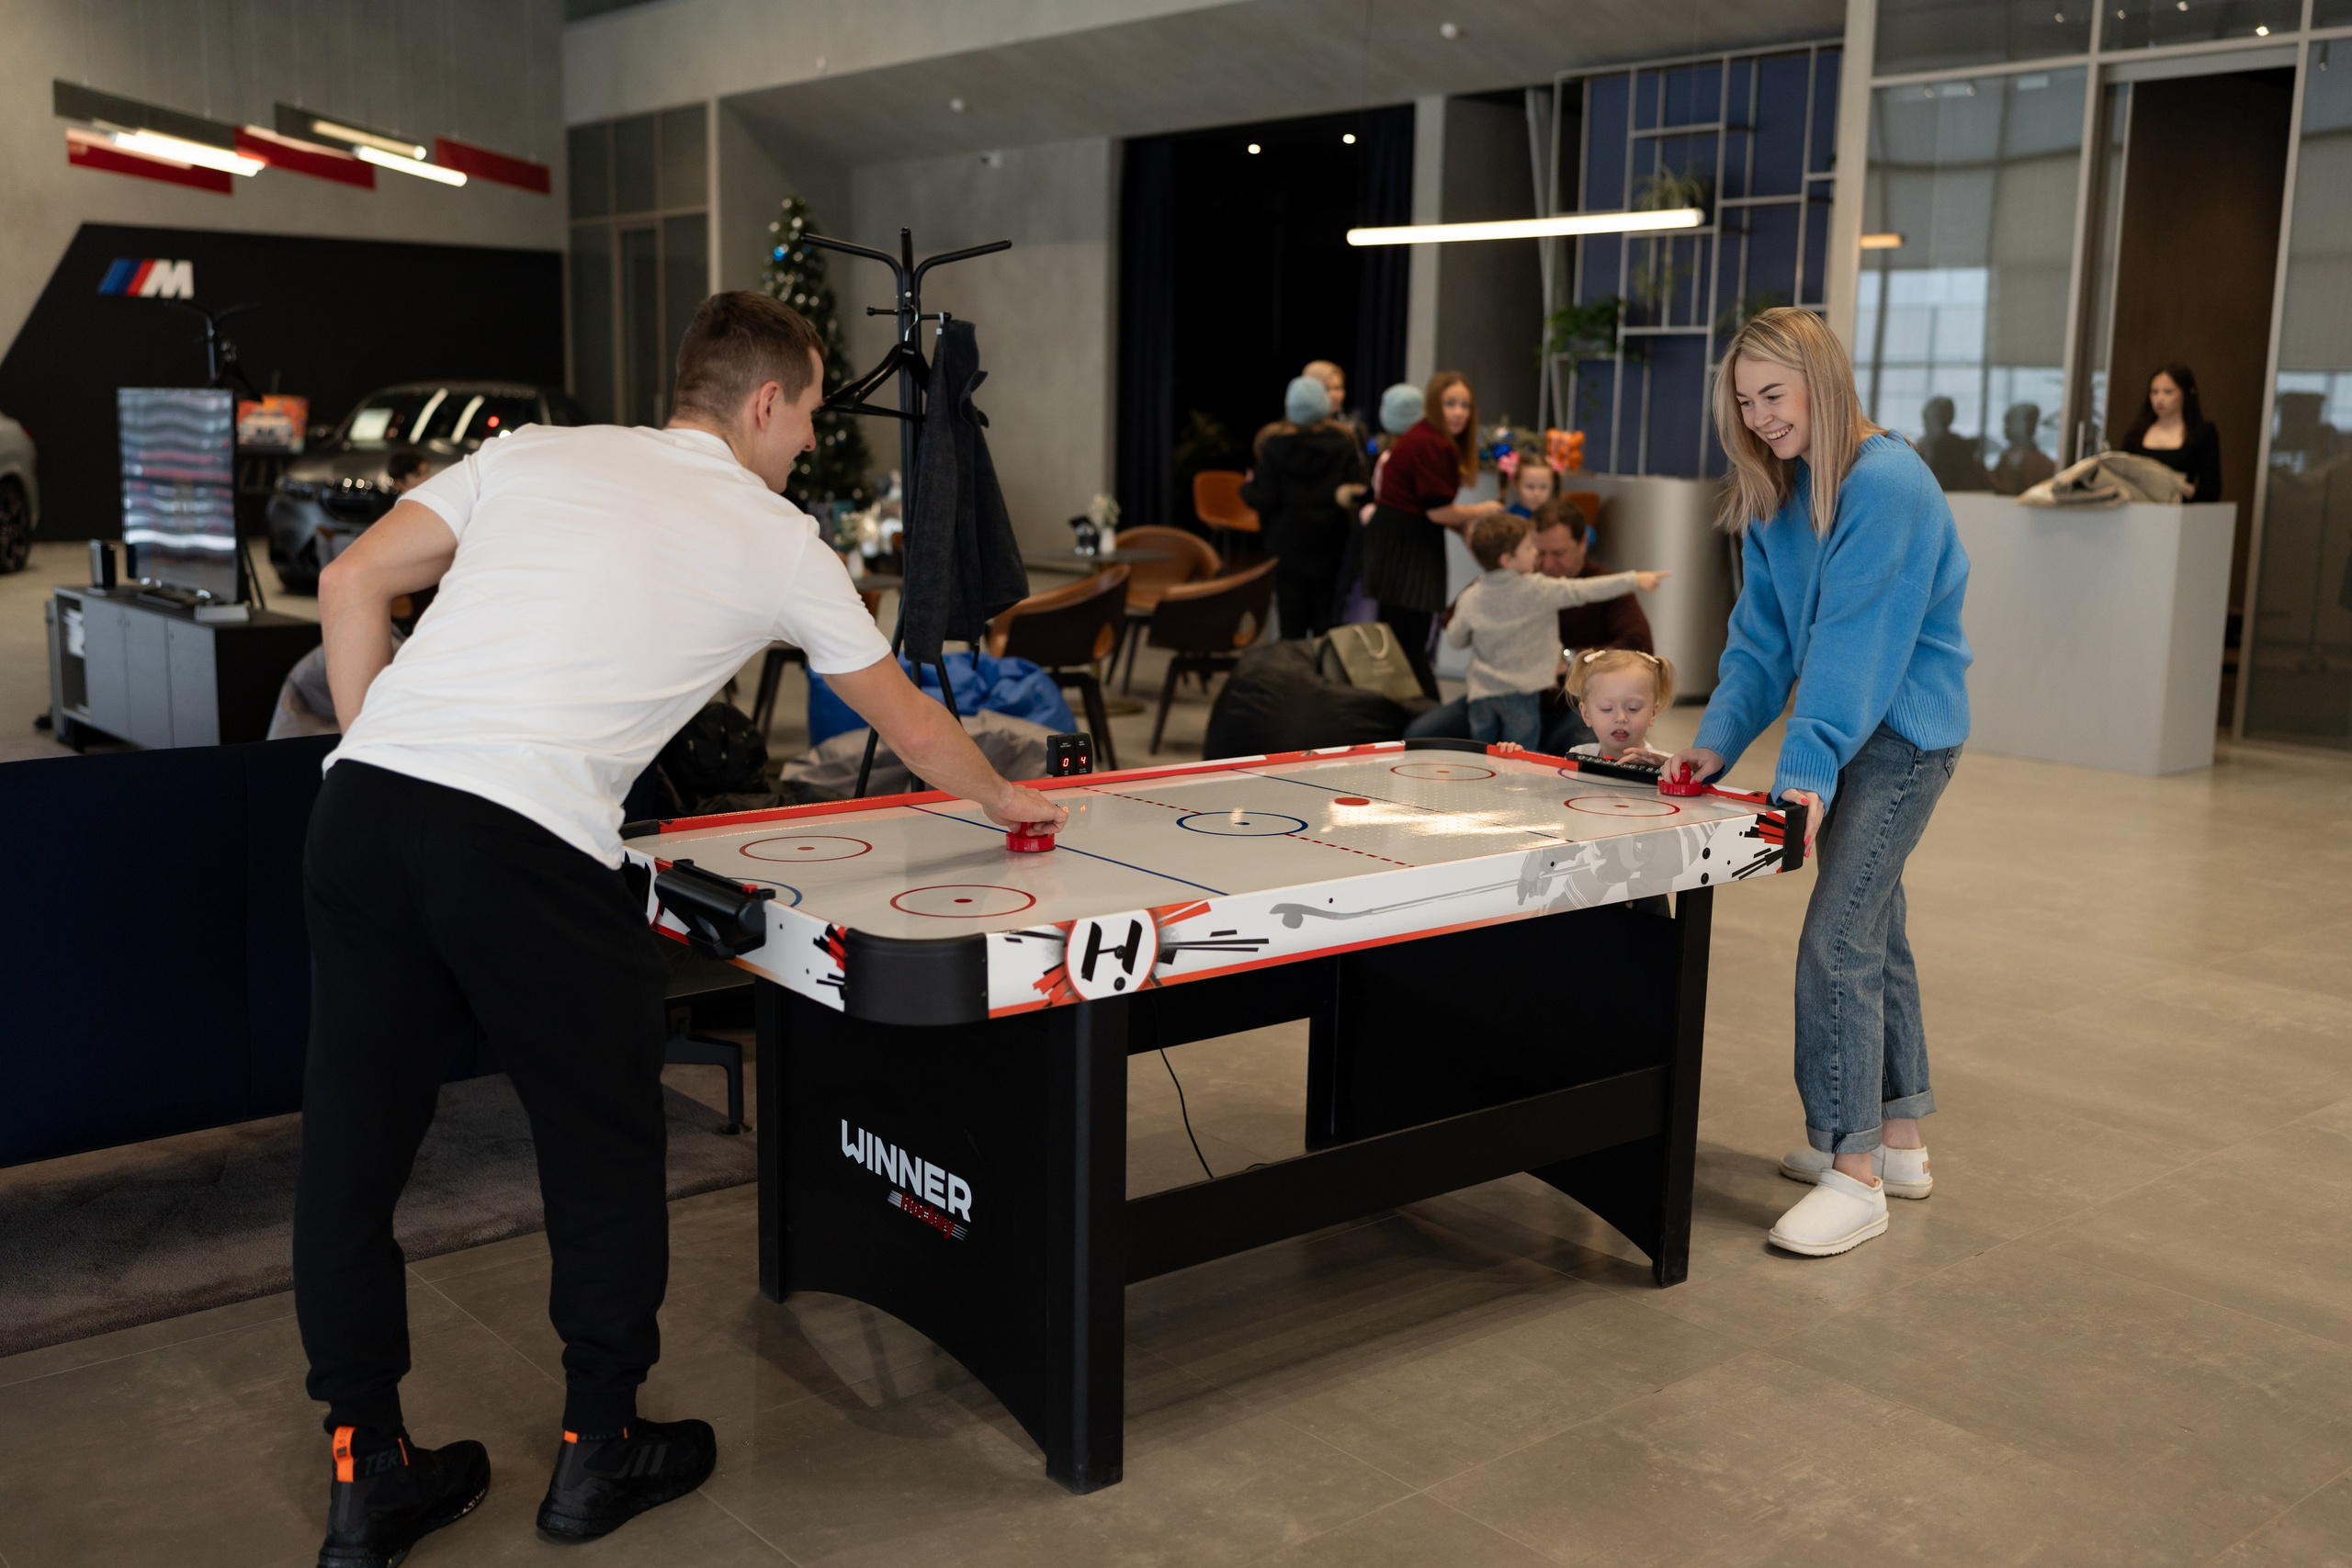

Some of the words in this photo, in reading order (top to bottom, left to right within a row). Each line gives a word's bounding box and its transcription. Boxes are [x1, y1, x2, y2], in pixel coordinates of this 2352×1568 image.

[140, 259, 194, 299] M
[1062, 758, 1069, 767] 0
[1080, 756, 1087, 764] 4
[842, 1118, 972, 1223] WINNER
[900, 1190, 956, 1239] Hockey
